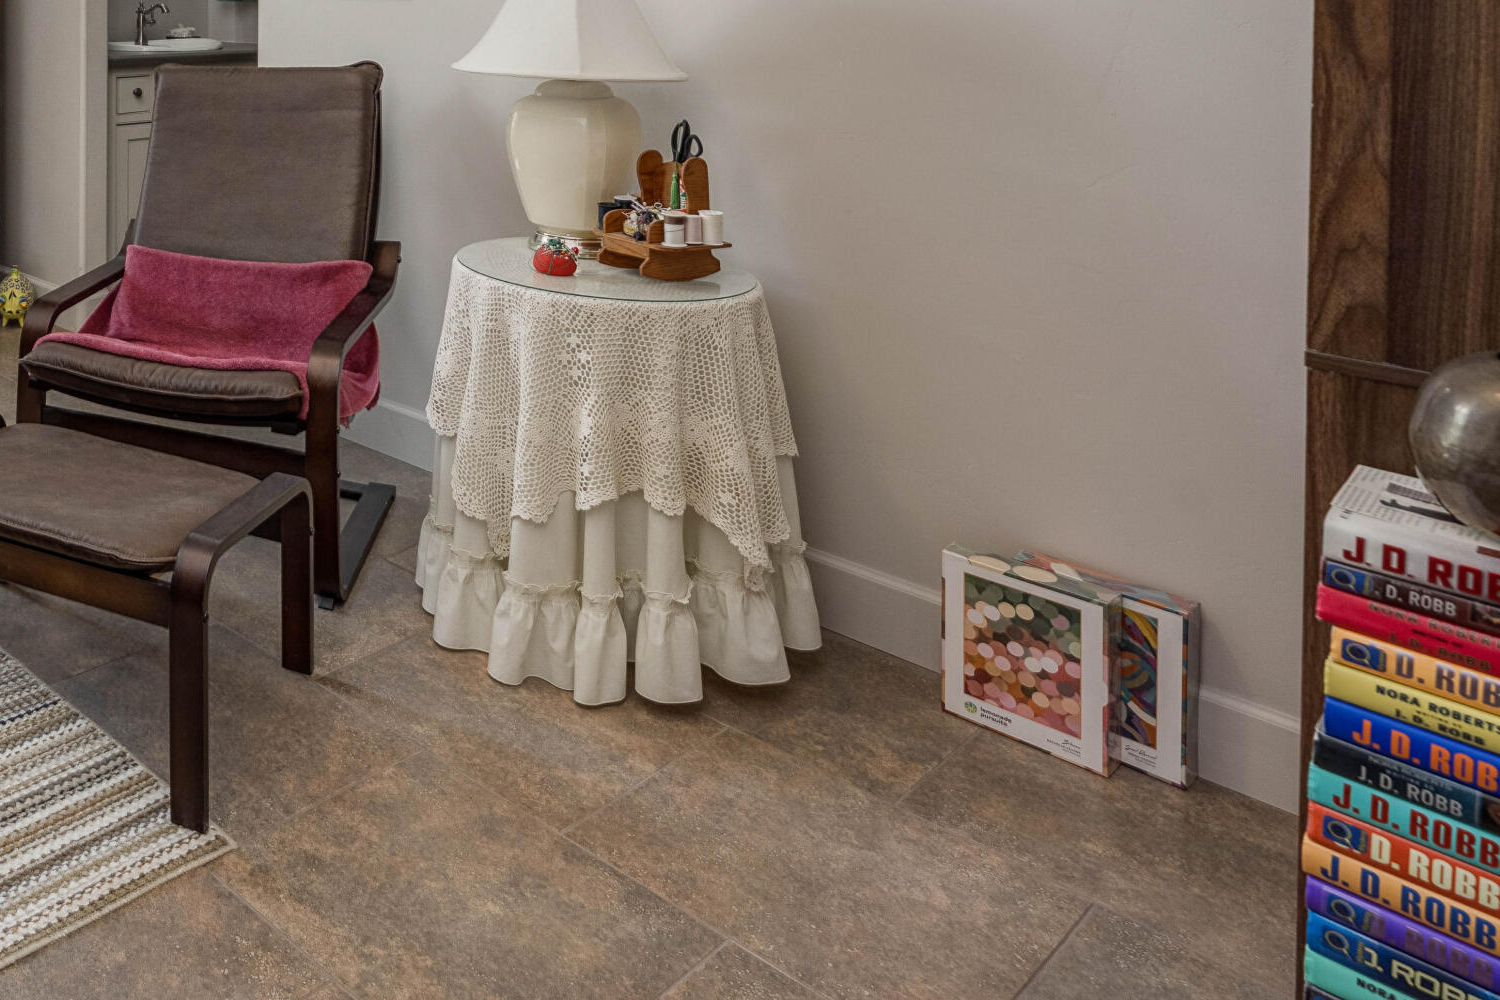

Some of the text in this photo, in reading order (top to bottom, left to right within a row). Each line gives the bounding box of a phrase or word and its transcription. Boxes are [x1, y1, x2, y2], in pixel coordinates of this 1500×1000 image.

[1342, 536, 1415, 579] J. D.
[1385, 584, 1457, 617] D. ROBB
[1368, 602, 1500, 652] NORA ROBER
[1375, 684, 1421, 707] NORA
[1396, 650, 1500, 708] D. ROB
[980, 706, 1012, 724] lemonade
[980, 712, 1008, 727] pursuits
[1438, 721, 1486, 746] ROBB
[1351, 718, 1499, 792] J. D. ROB
[1379, 773, 1399, 794] D.
[1406, 782, 1463, 818] ROBB
[1332, 783, 1500, 868] J. D. ROBB
[1408, 846, 1500, 910] ROBB
[1320, 855, 1497, 950] J. D. ROBB
